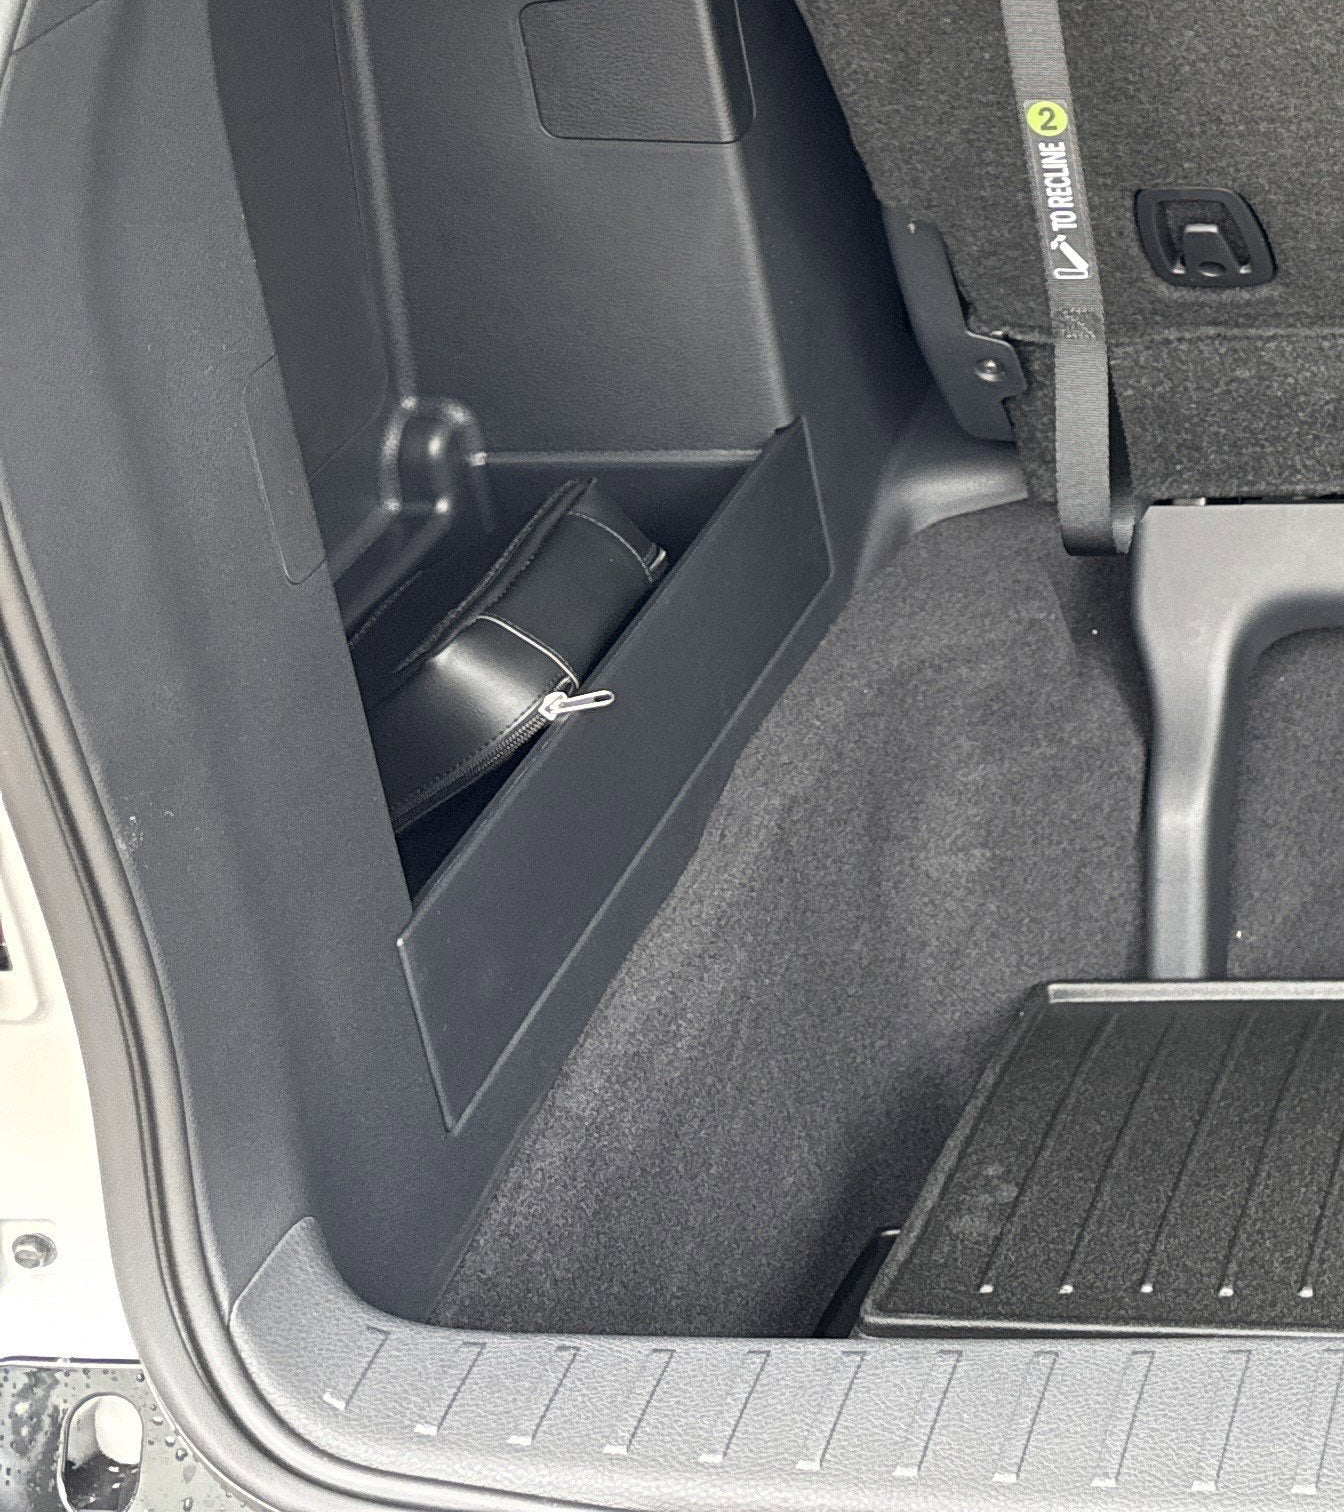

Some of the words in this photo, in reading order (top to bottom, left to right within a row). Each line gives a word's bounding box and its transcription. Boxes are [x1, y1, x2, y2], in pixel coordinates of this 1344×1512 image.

[1038, 106, 1058, 131] 2
[1038, 141, 1075, 208] RECLINE
[1049, 210, 1078, 232] TO
